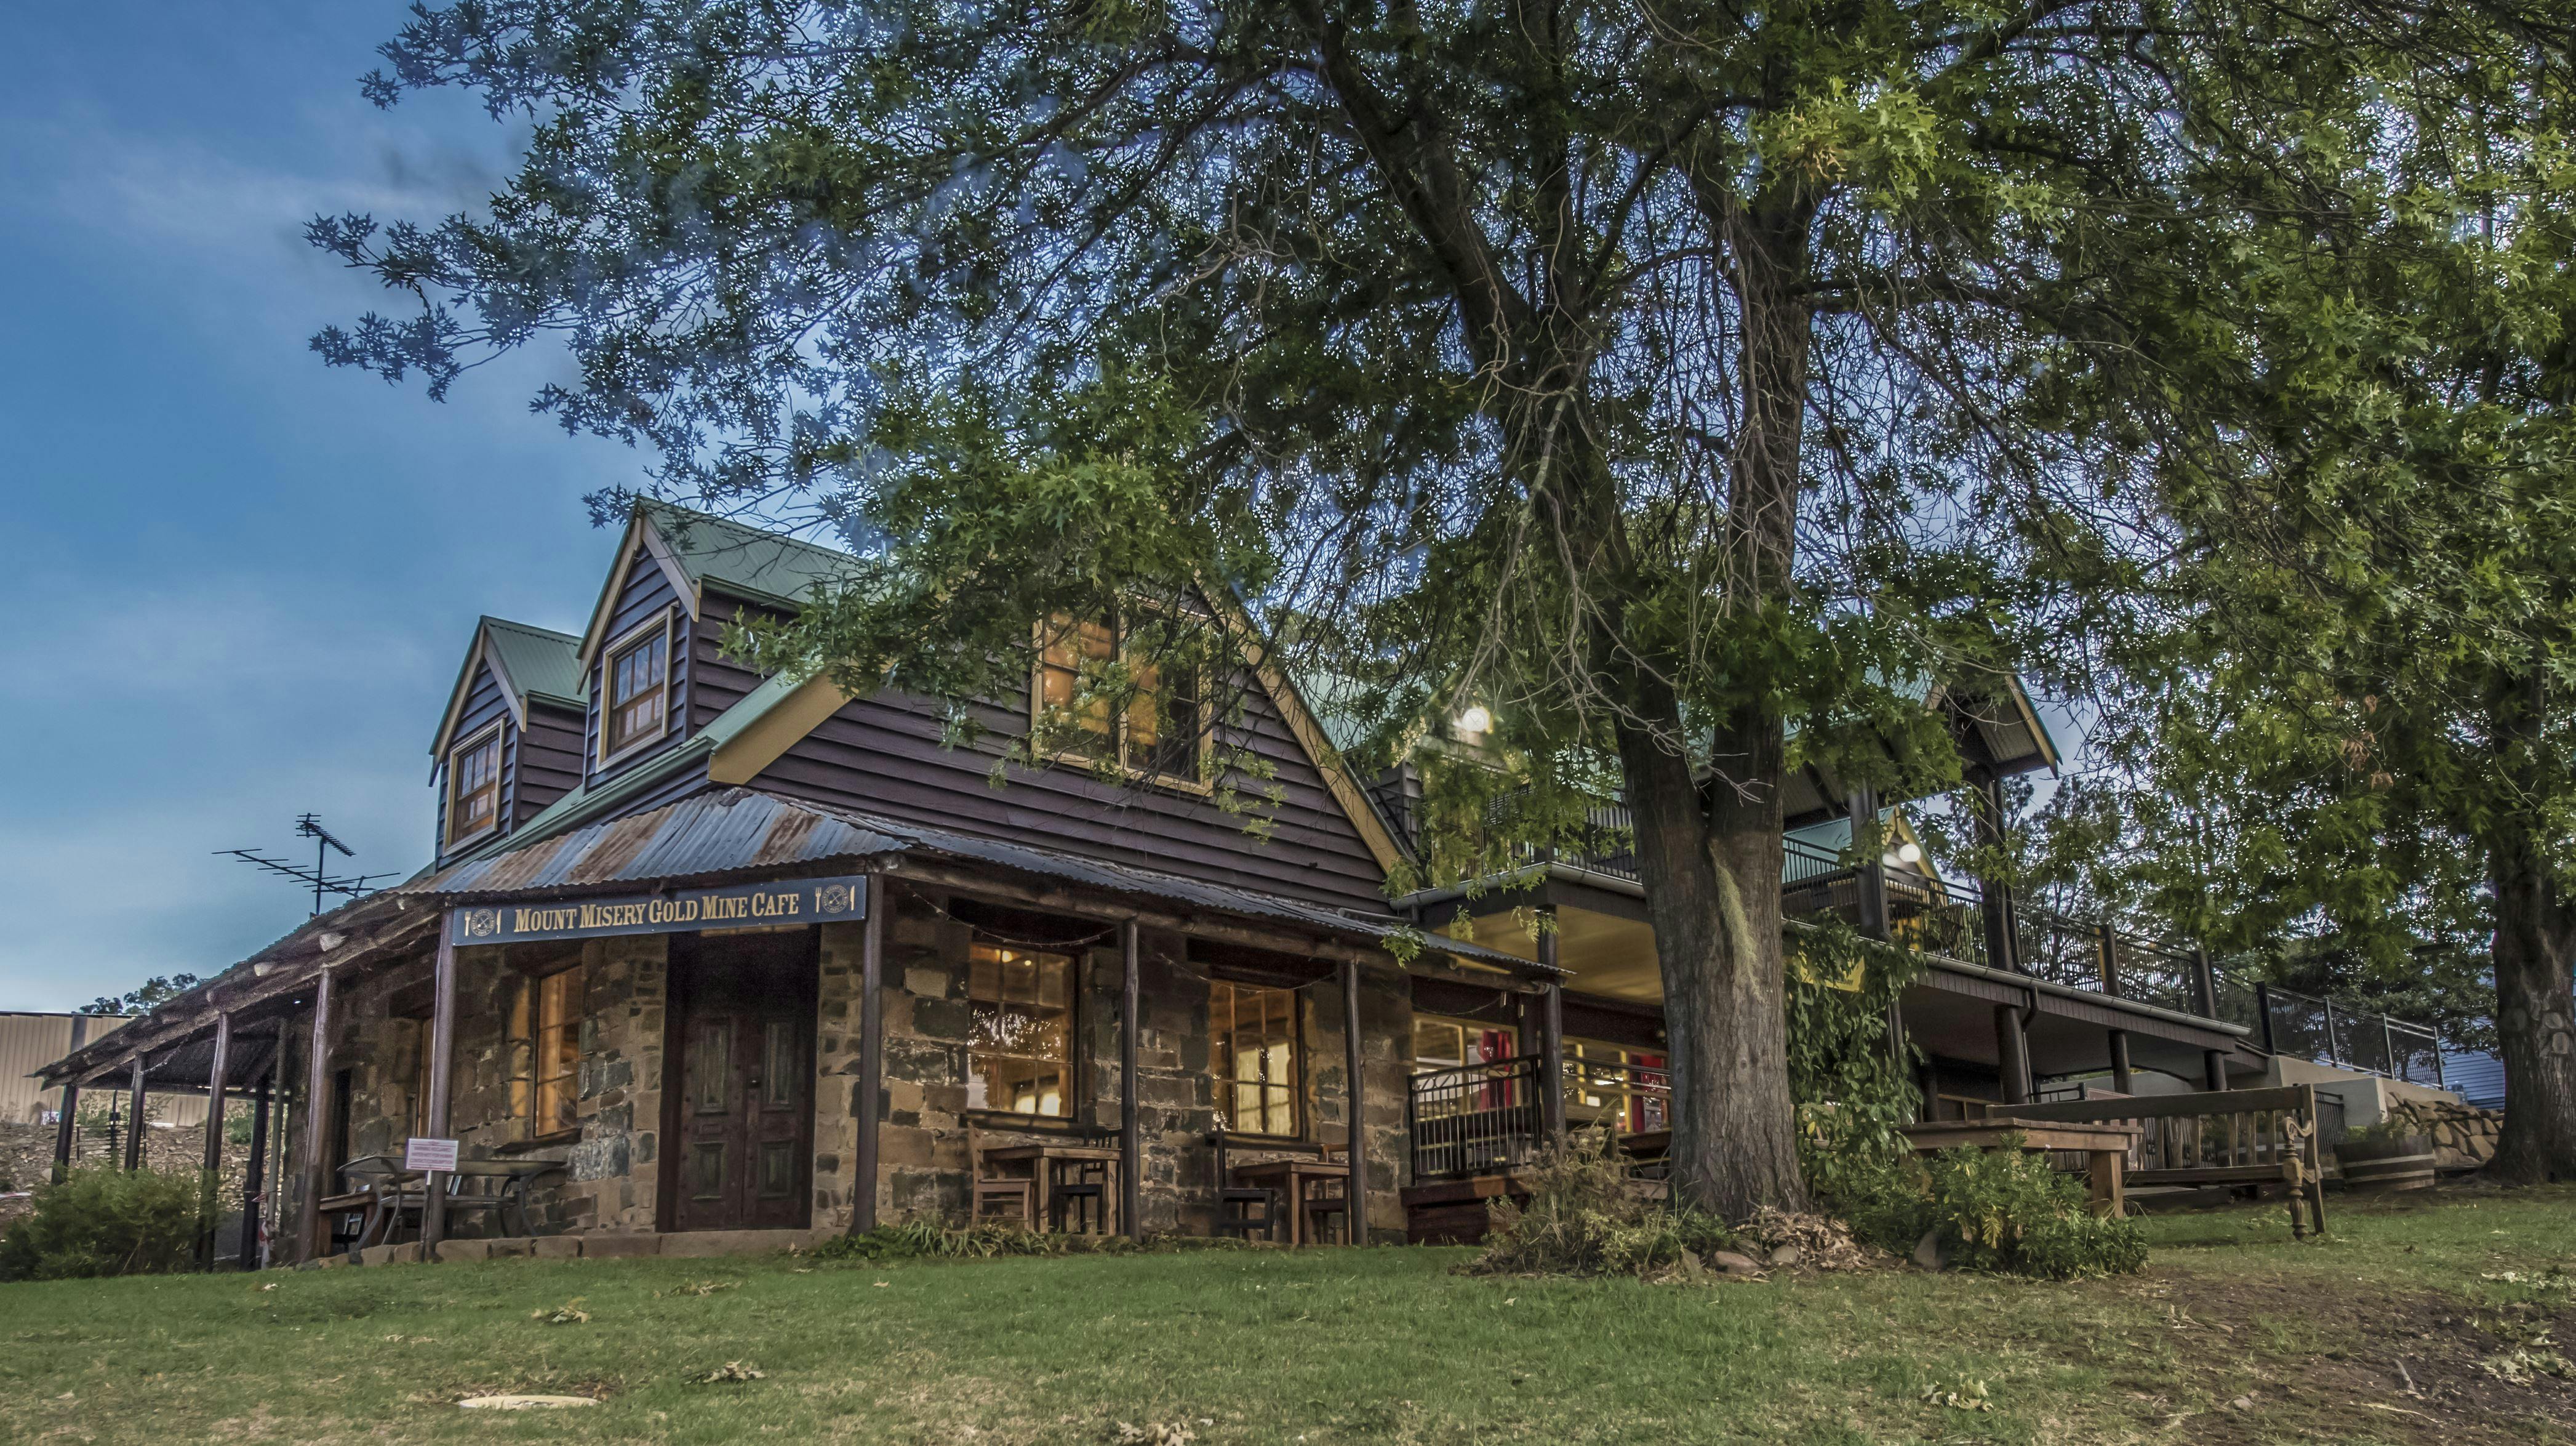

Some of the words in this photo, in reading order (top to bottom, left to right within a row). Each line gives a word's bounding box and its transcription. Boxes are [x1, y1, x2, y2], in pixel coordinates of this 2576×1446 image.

[514, 908, 577, 933] MOUNT
[579, 904, 647, 928] MISERY
[649, 899, 698, 923] GOLD
[701, 895, 748, 920] MINE
[751, 893, 799, 917] CAFE
